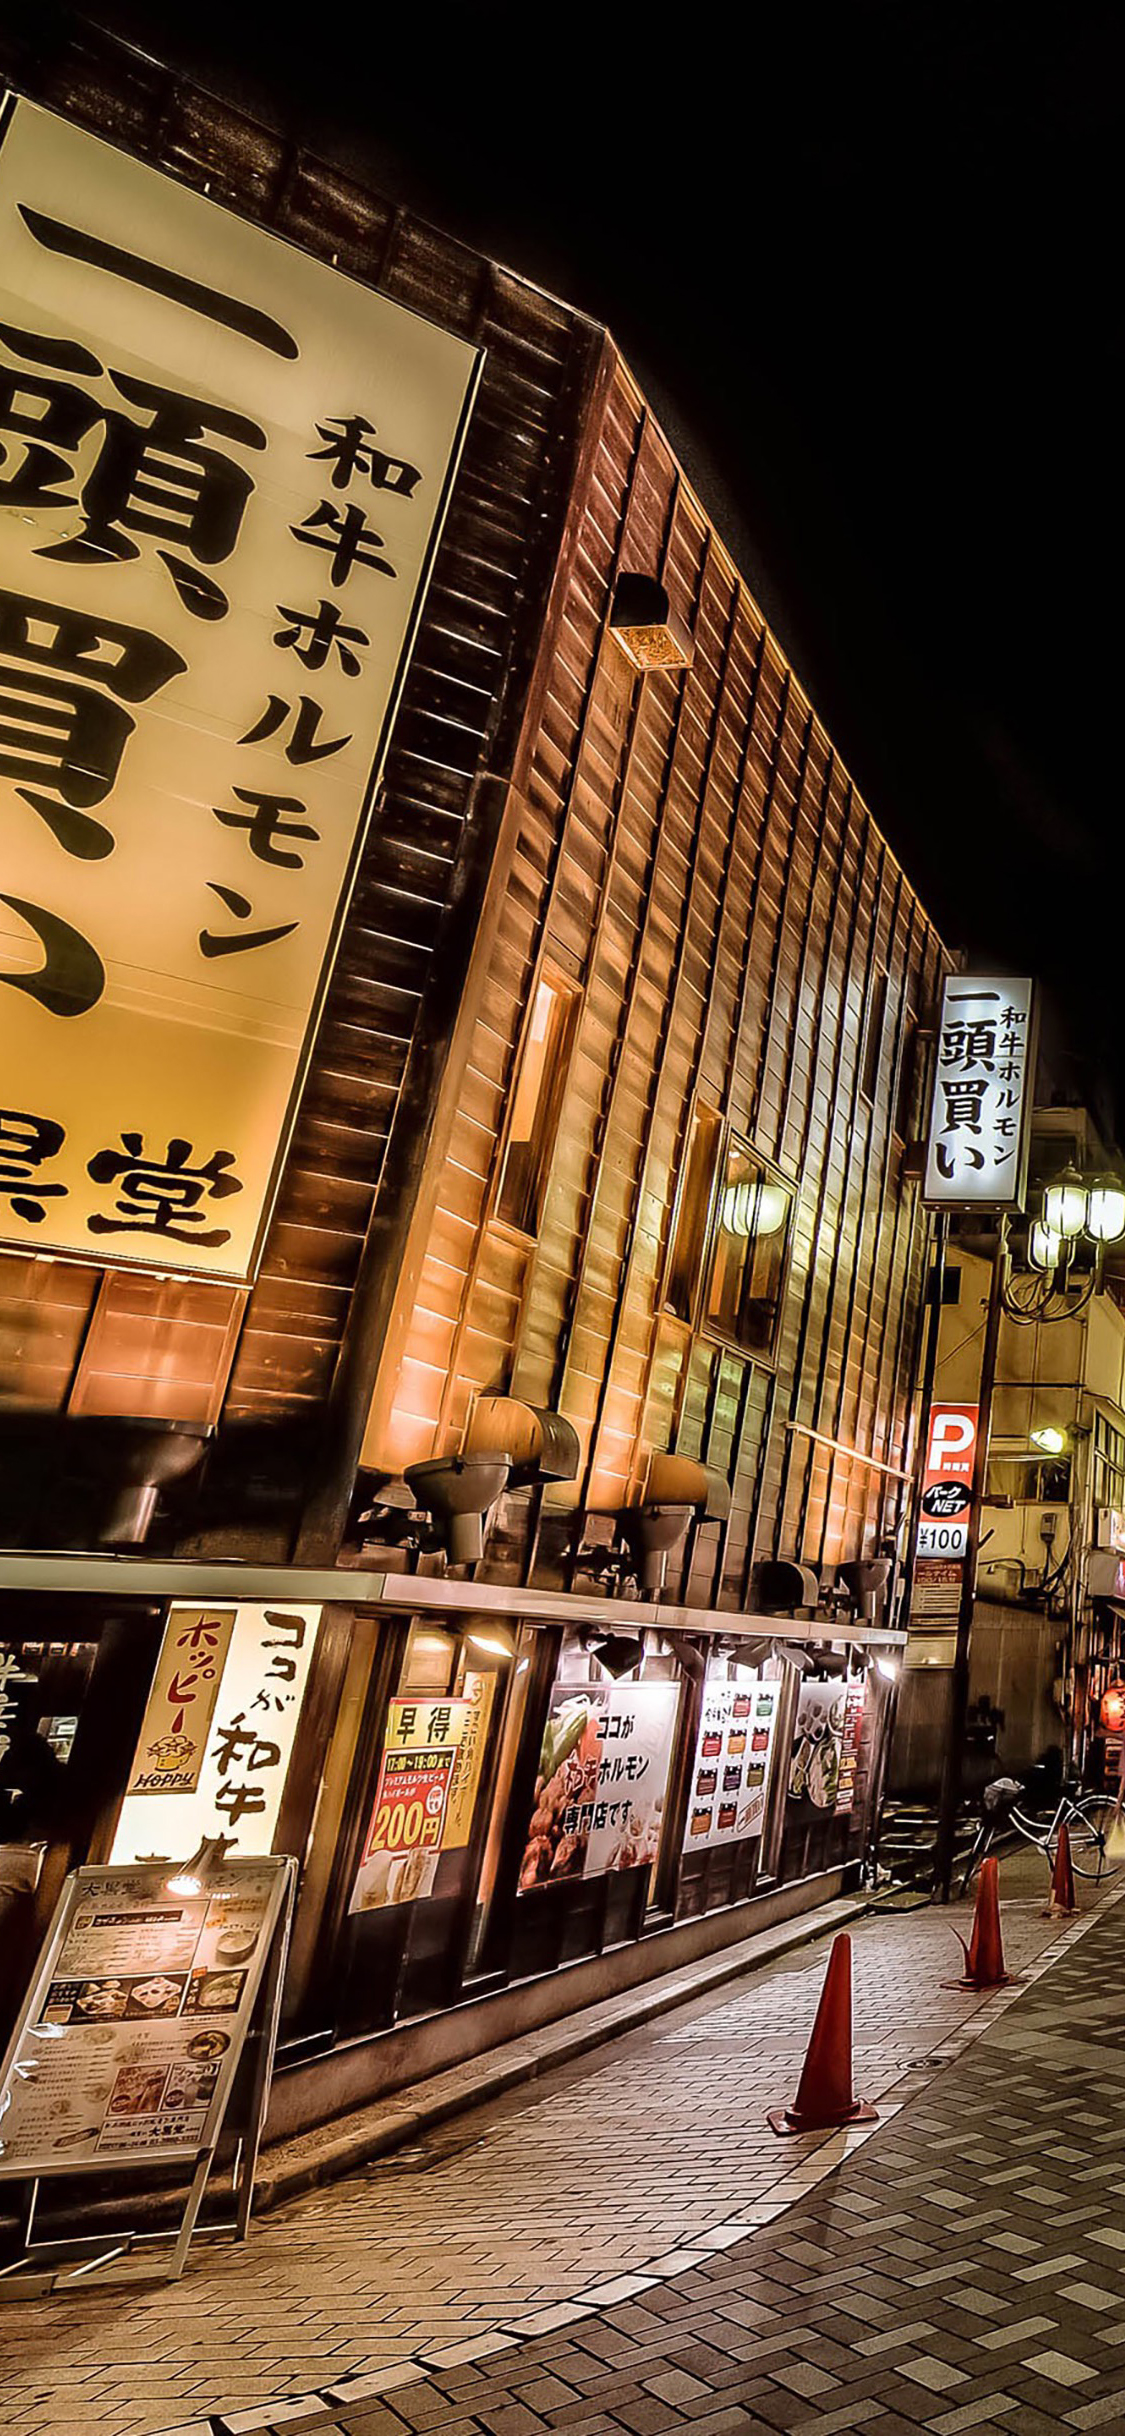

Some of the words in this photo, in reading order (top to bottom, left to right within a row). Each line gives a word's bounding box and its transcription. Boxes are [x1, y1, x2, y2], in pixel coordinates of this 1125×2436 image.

[200, 414, 422, 958] 和牛ホルモン
[935, 990, 1000, 1179] 一頭買い
[993, 1005, 1027, 1166] 和牛ホルモン
[928, 1414, 975, 1471] P
[926, 1486, 962, 1499] パーク
[931, 1500, 966, 1514] NET
[919, 1527, 962, 1550] ¥100
[167, 1615, 222, 1734] ホッピー
[396, 1706, 451, 1745] 早得
[596, 1715, 635, 1739] ココが
[370, 1801, 440, 1850] 200円
